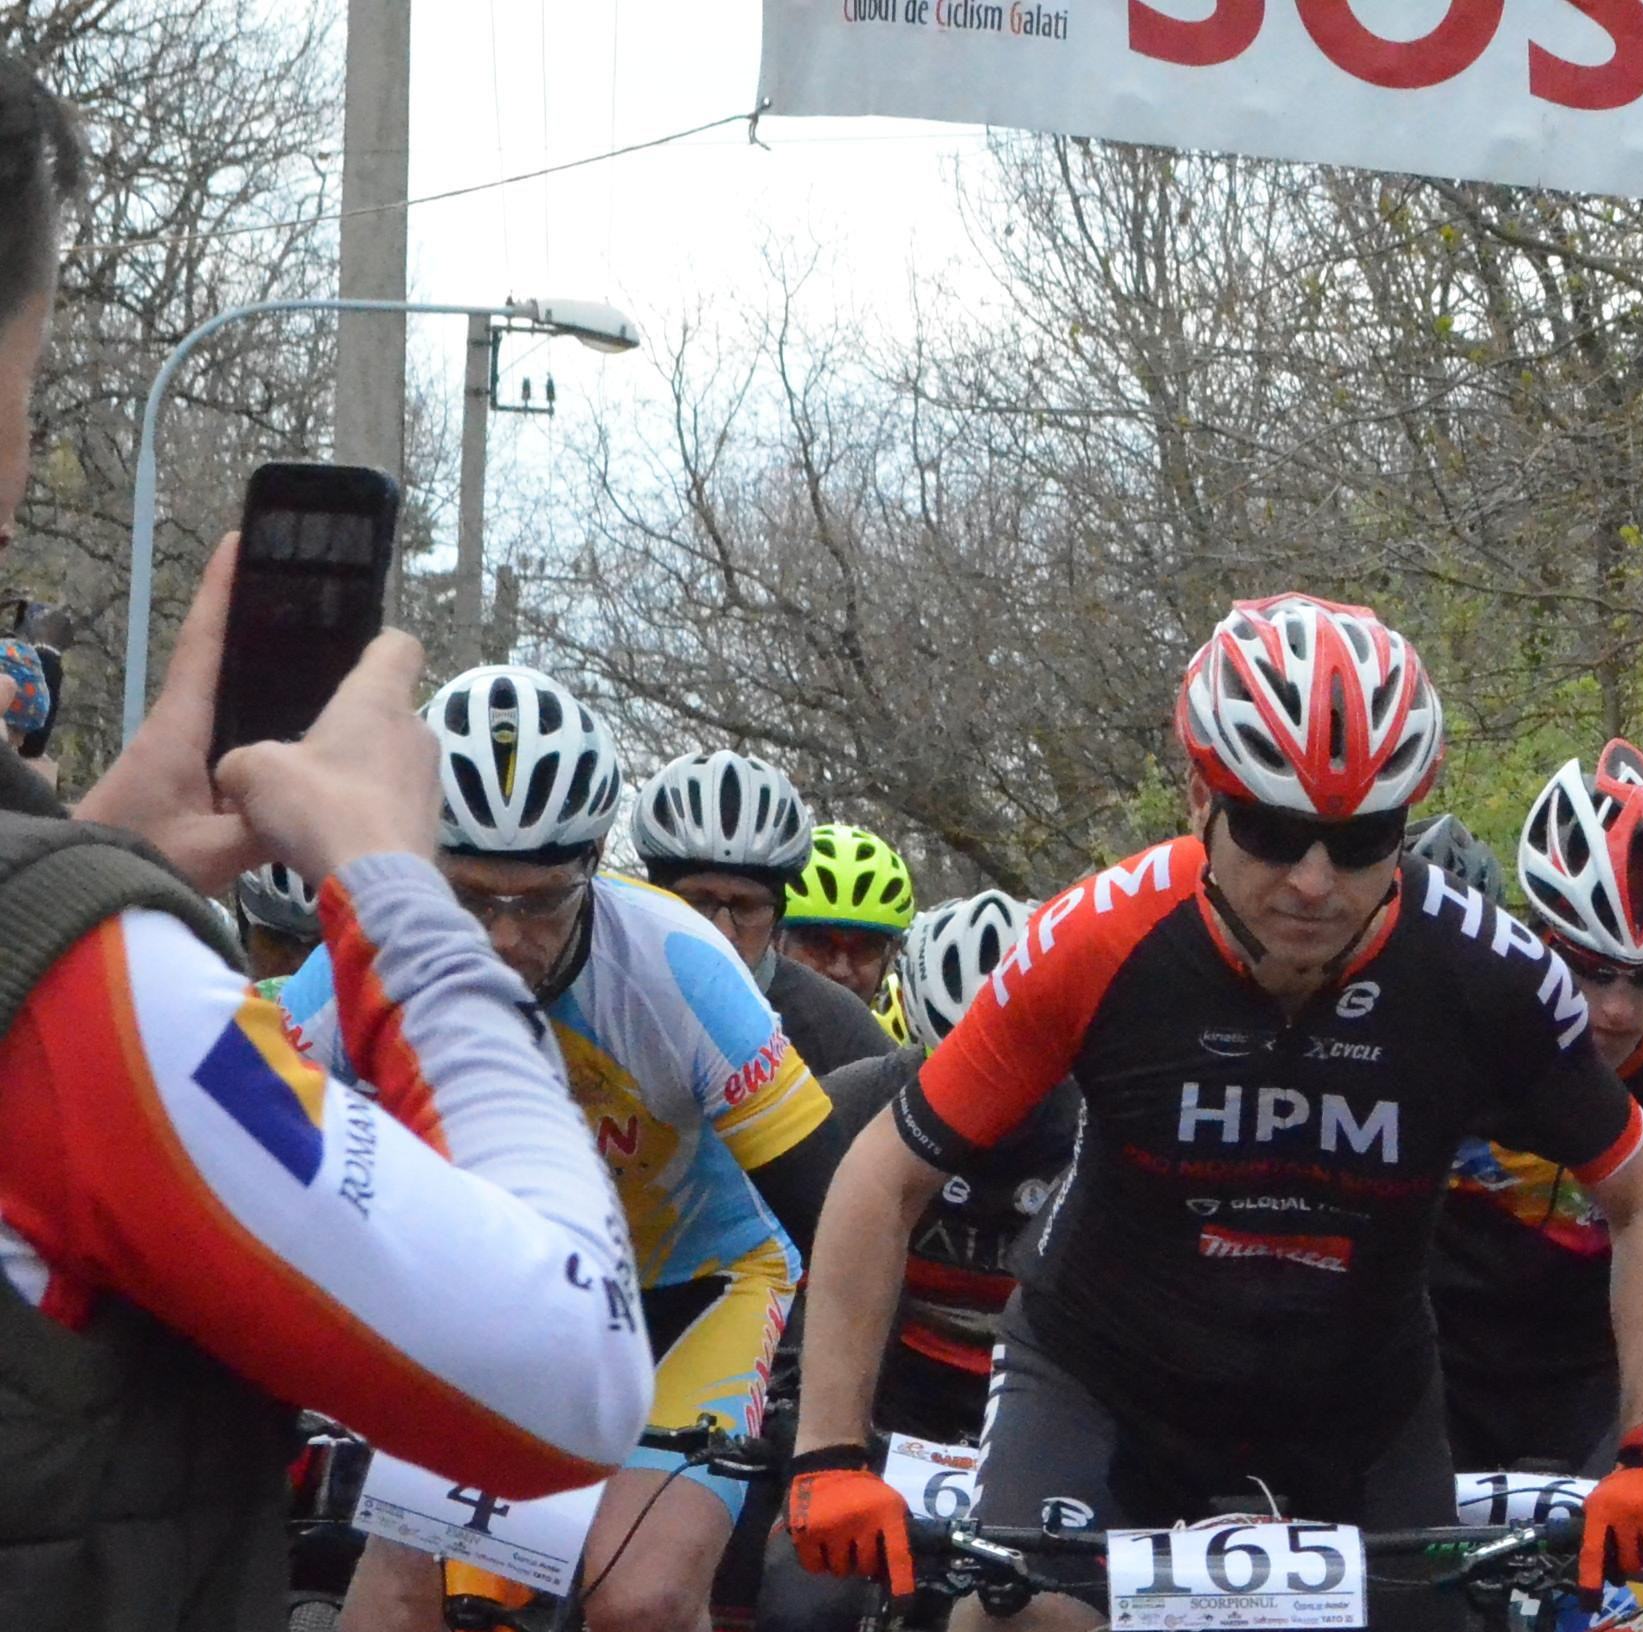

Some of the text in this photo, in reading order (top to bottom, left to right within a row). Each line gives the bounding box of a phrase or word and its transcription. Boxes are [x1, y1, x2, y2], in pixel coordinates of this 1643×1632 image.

[904, 1, 928, 26] de
[935, 0, 1001, 32] Ciclism
[1009, 1, 1068, 40] Galati
[991, 845, 1173, 1008] HPM
[1422, 864, 1589, 1050] HPM
[1178, 1082, 1400, 1164] HPM
[1132, 1524, 1346, 1594] 165
[1190, 1597, 1279, 1610] SCORPIONUL
